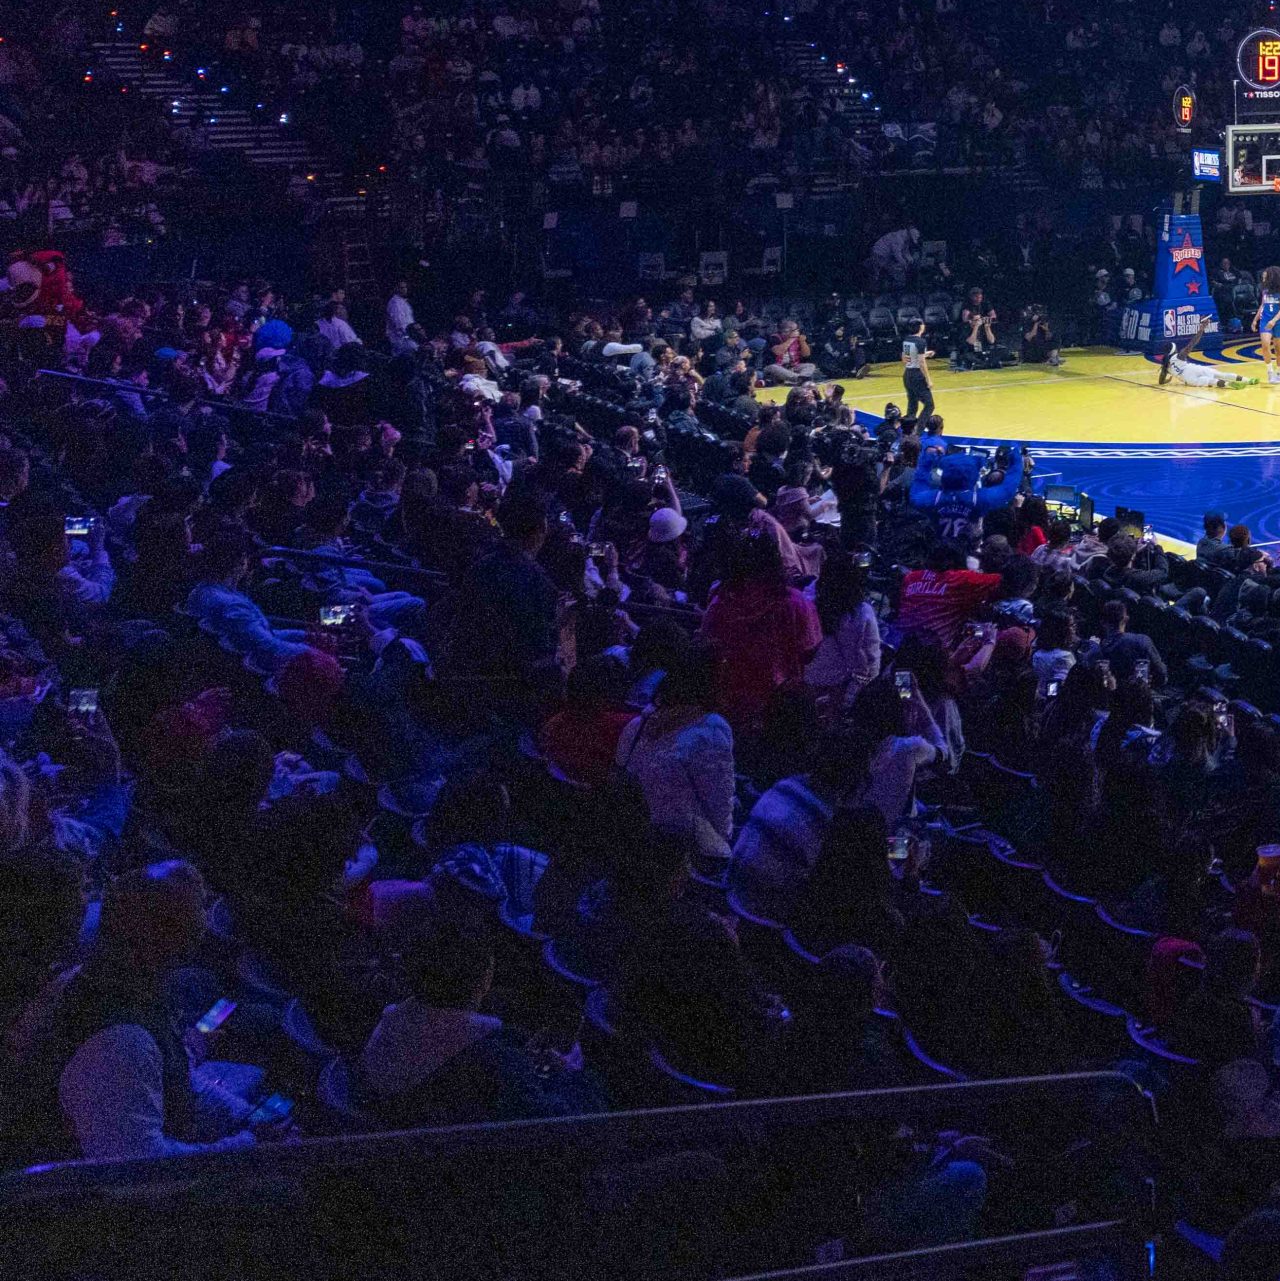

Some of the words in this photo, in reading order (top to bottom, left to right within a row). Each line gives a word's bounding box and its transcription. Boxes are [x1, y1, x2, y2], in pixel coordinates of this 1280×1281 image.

[1259, 41, 1280, 56] 1:22
[1258, 56, 1280, 81] 19
[1173, 249, 1201, 262] RUFFLES
